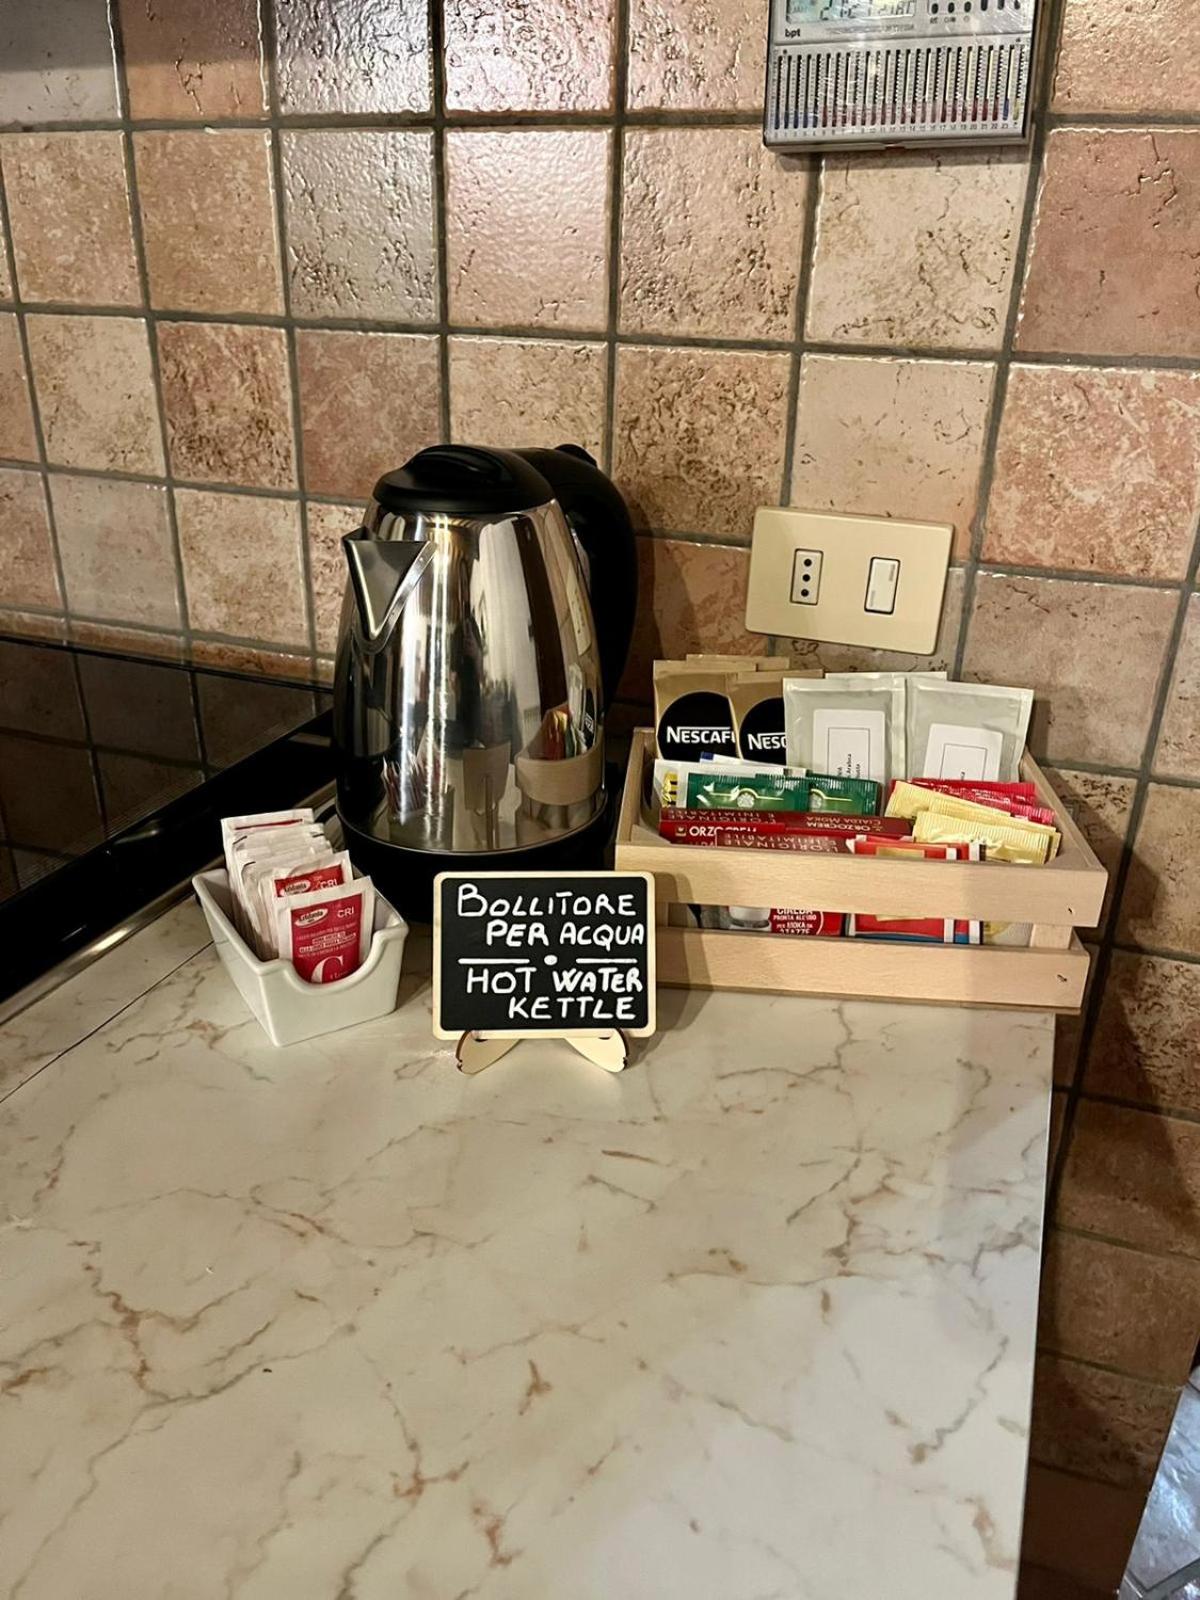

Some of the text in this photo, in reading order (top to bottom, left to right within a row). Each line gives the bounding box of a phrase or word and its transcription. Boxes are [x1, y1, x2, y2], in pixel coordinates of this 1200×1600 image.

[785, 28, 801, 39] bpt
[336, 906, 355, 918] CRI
[457, 883, 636, 917] BOLLITORE
[486, 919, 645, 952] PER ACQUA
[466, 966, 643, 994] HOT WATER
[508, 996, 636, 1020] KETTLE
